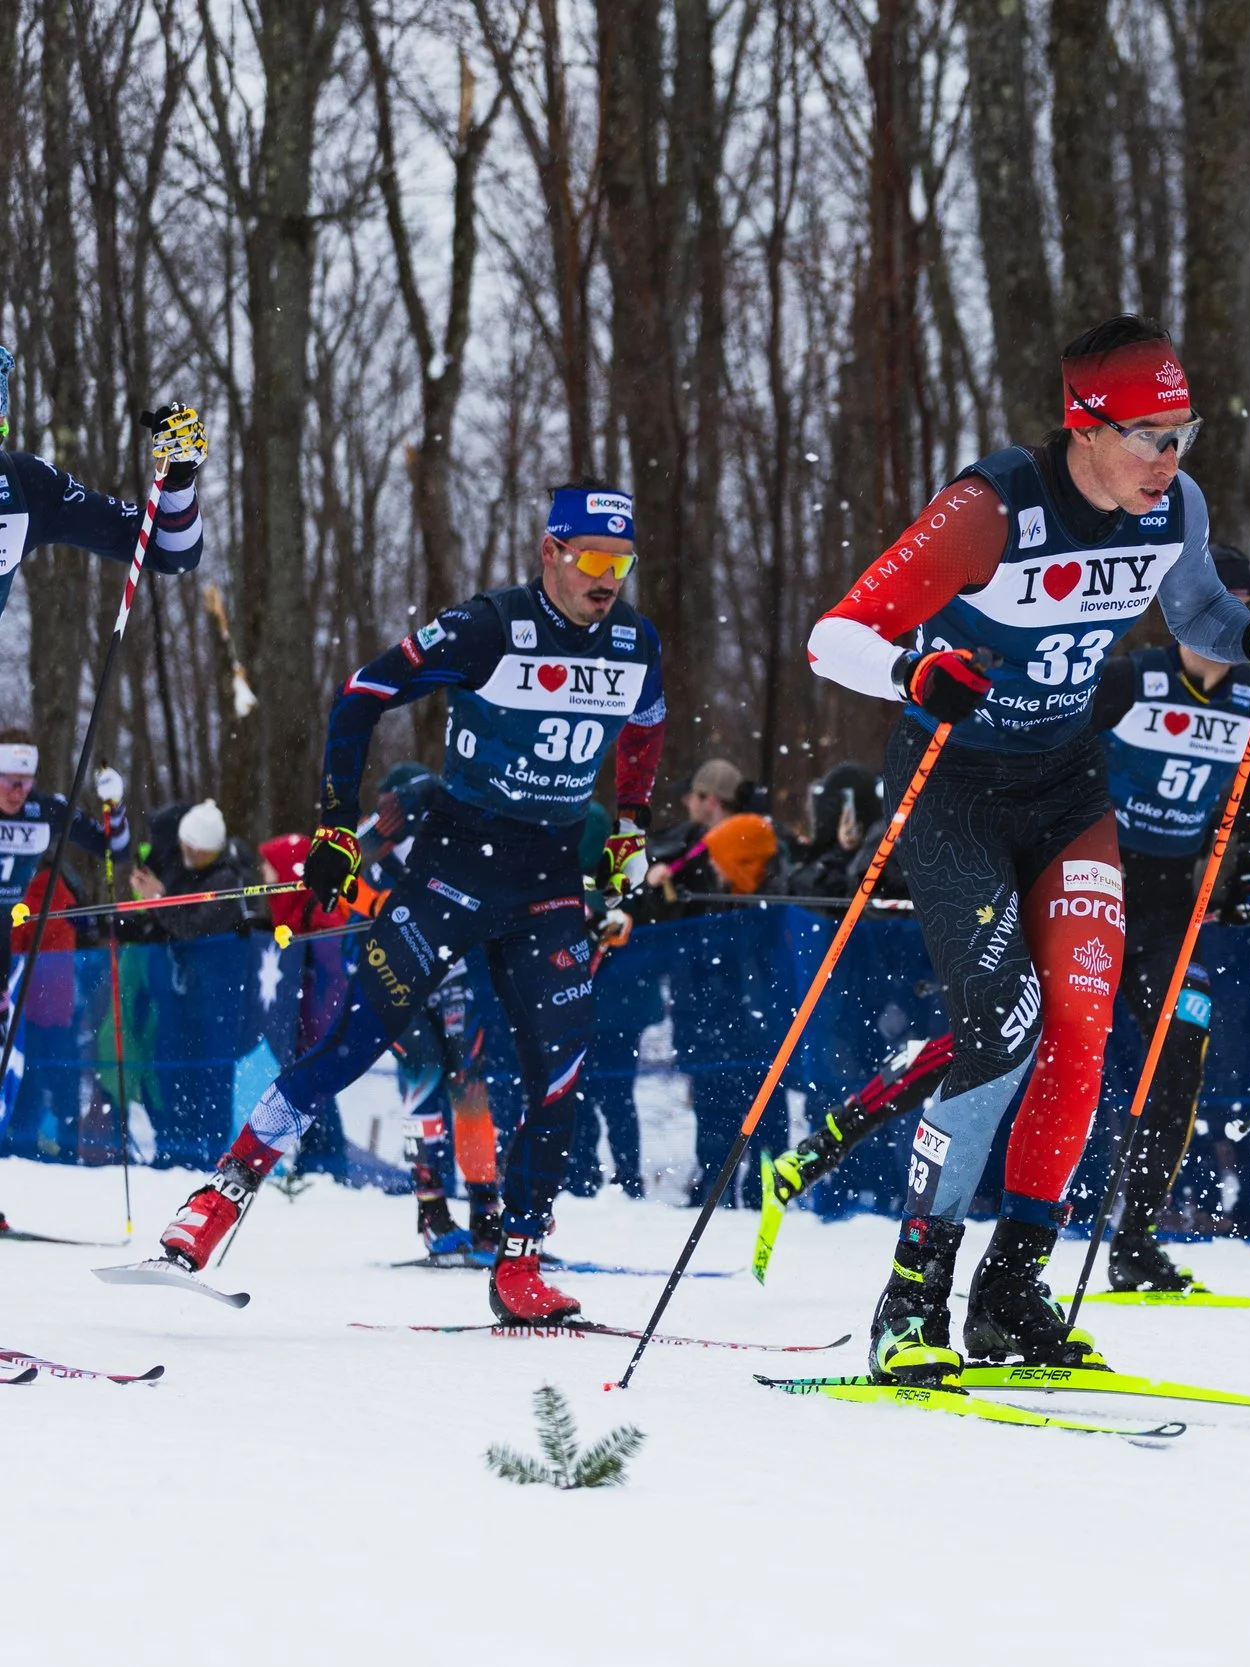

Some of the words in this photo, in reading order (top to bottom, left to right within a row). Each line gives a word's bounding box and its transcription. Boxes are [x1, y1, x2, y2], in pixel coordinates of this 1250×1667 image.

[1140, 516, 1167, 528] coop
[850, 486, 984, 604] PEMBROKE
[1017, 566, 1042, 604] I
[1080, 597, 1150, 613] iloveny.com
[612, 640, 634, 651] coop
[1027, 629, 1114, 686] 33
[517, 663, 534, 690] I
[569, 695, 626, 708] iloveny.com
[986, 688, 1039, 713] Lake
[1144, 708, 1163, 733] I
[1191, 714, 1240, 745] NY
[534, 717, 604, 764] 30
[505, 763, 550, 787] Lake
[1157, 758, 1212, 802] 51
[533, 793, 550, 801] VAN
[1126, 796, 1163, 819] Lake
[1065, 874, 1089, 882] CAN
[1099, 876, 1122, 891] FUND
[1194, 896, 1209, 928] REMIO
[366, 938, 411, 1007] somfy
[1075, 985, 1107, 997] CANADA
[922, 1130, 945, 1153] NY
[1010, 1369, 1072, 1382] FISCHER
[895, 1389, 931, 1403] FISCHER
